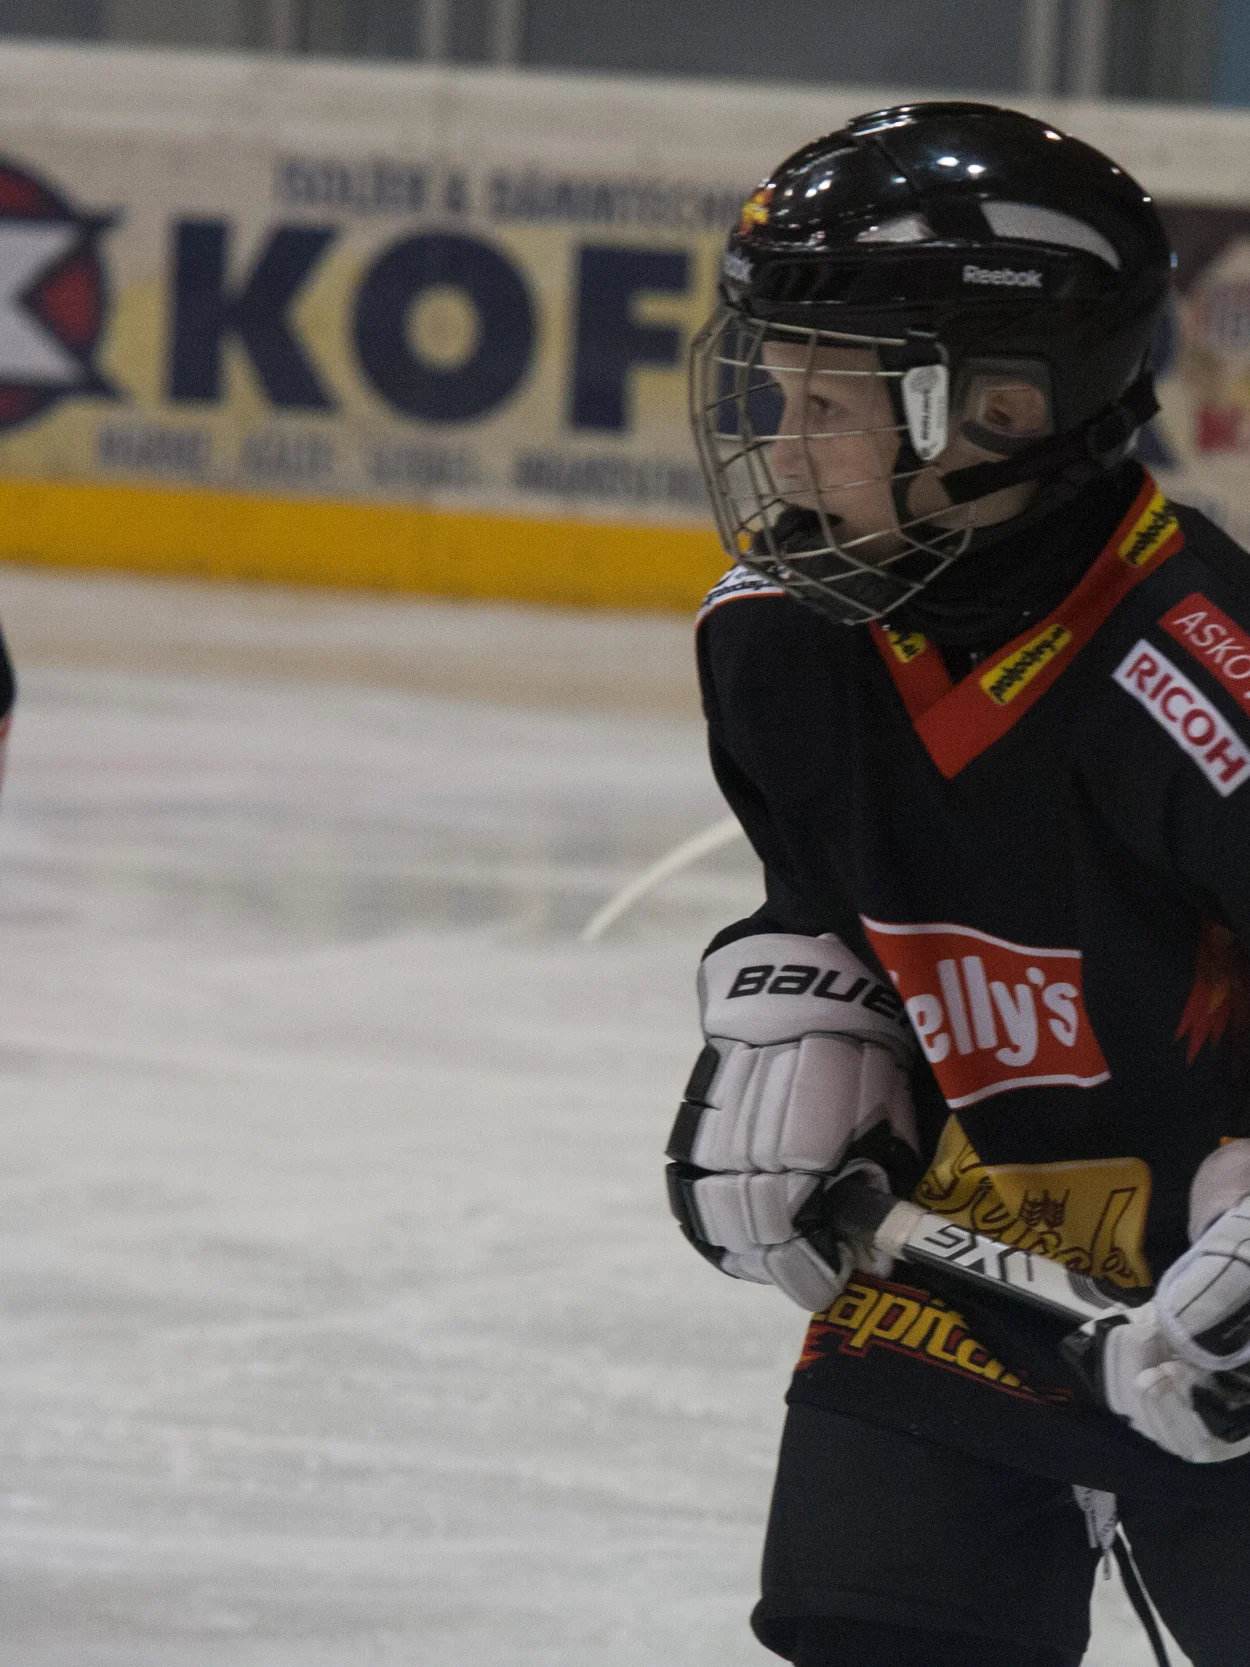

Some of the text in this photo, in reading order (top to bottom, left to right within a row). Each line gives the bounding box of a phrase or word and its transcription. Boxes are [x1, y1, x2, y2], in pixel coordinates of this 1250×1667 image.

[962, 264, 1043, 288] Reebok
[1123, 651, 1249, 784] RICOH
[726, 964, 907, 1019] BAUE
[887, 955, 1078, 1067] elly's
[813, 1283, 1022, 1388] apita
